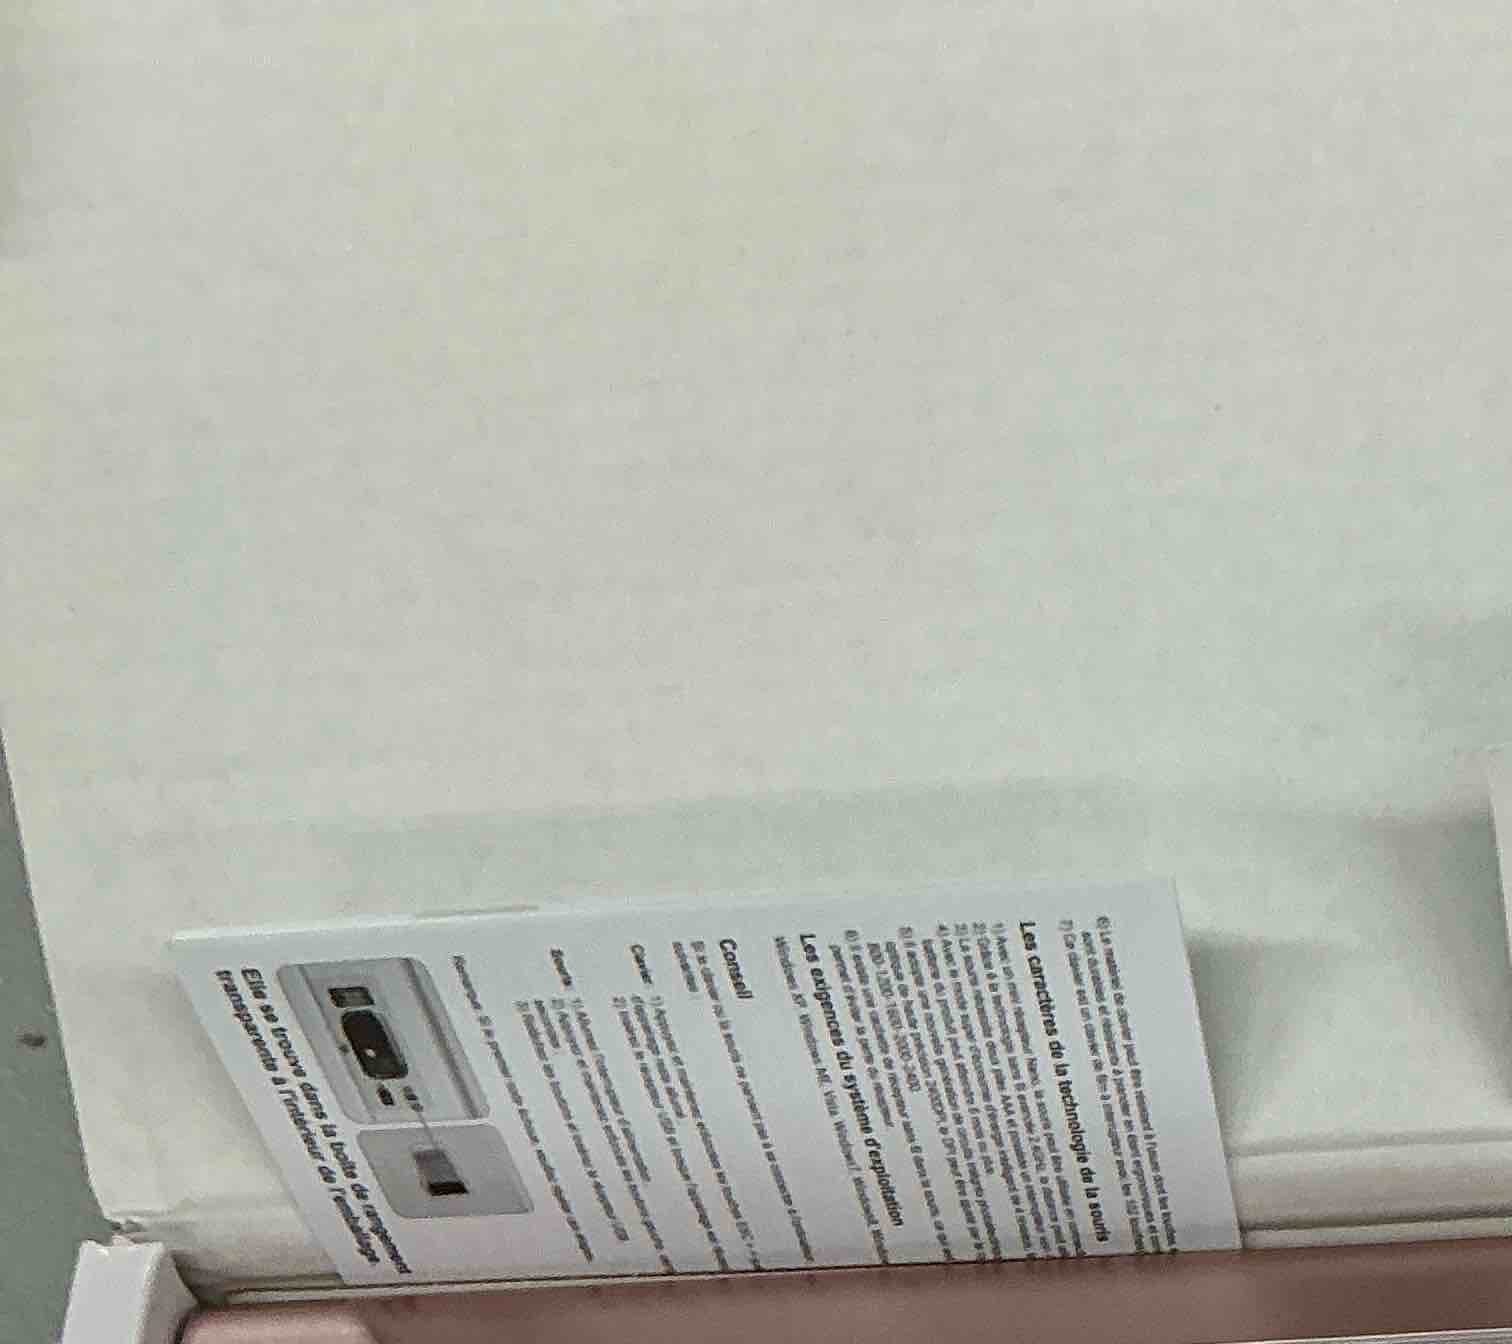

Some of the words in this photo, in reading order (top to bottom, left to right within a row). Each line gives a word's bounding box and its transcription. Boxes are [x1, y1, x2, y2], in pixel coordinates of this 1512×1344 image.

[799, 934, 820, 963] Les
[1019, 922, 1038, 951] Les
[718, 938, 752, 999] Conseil
